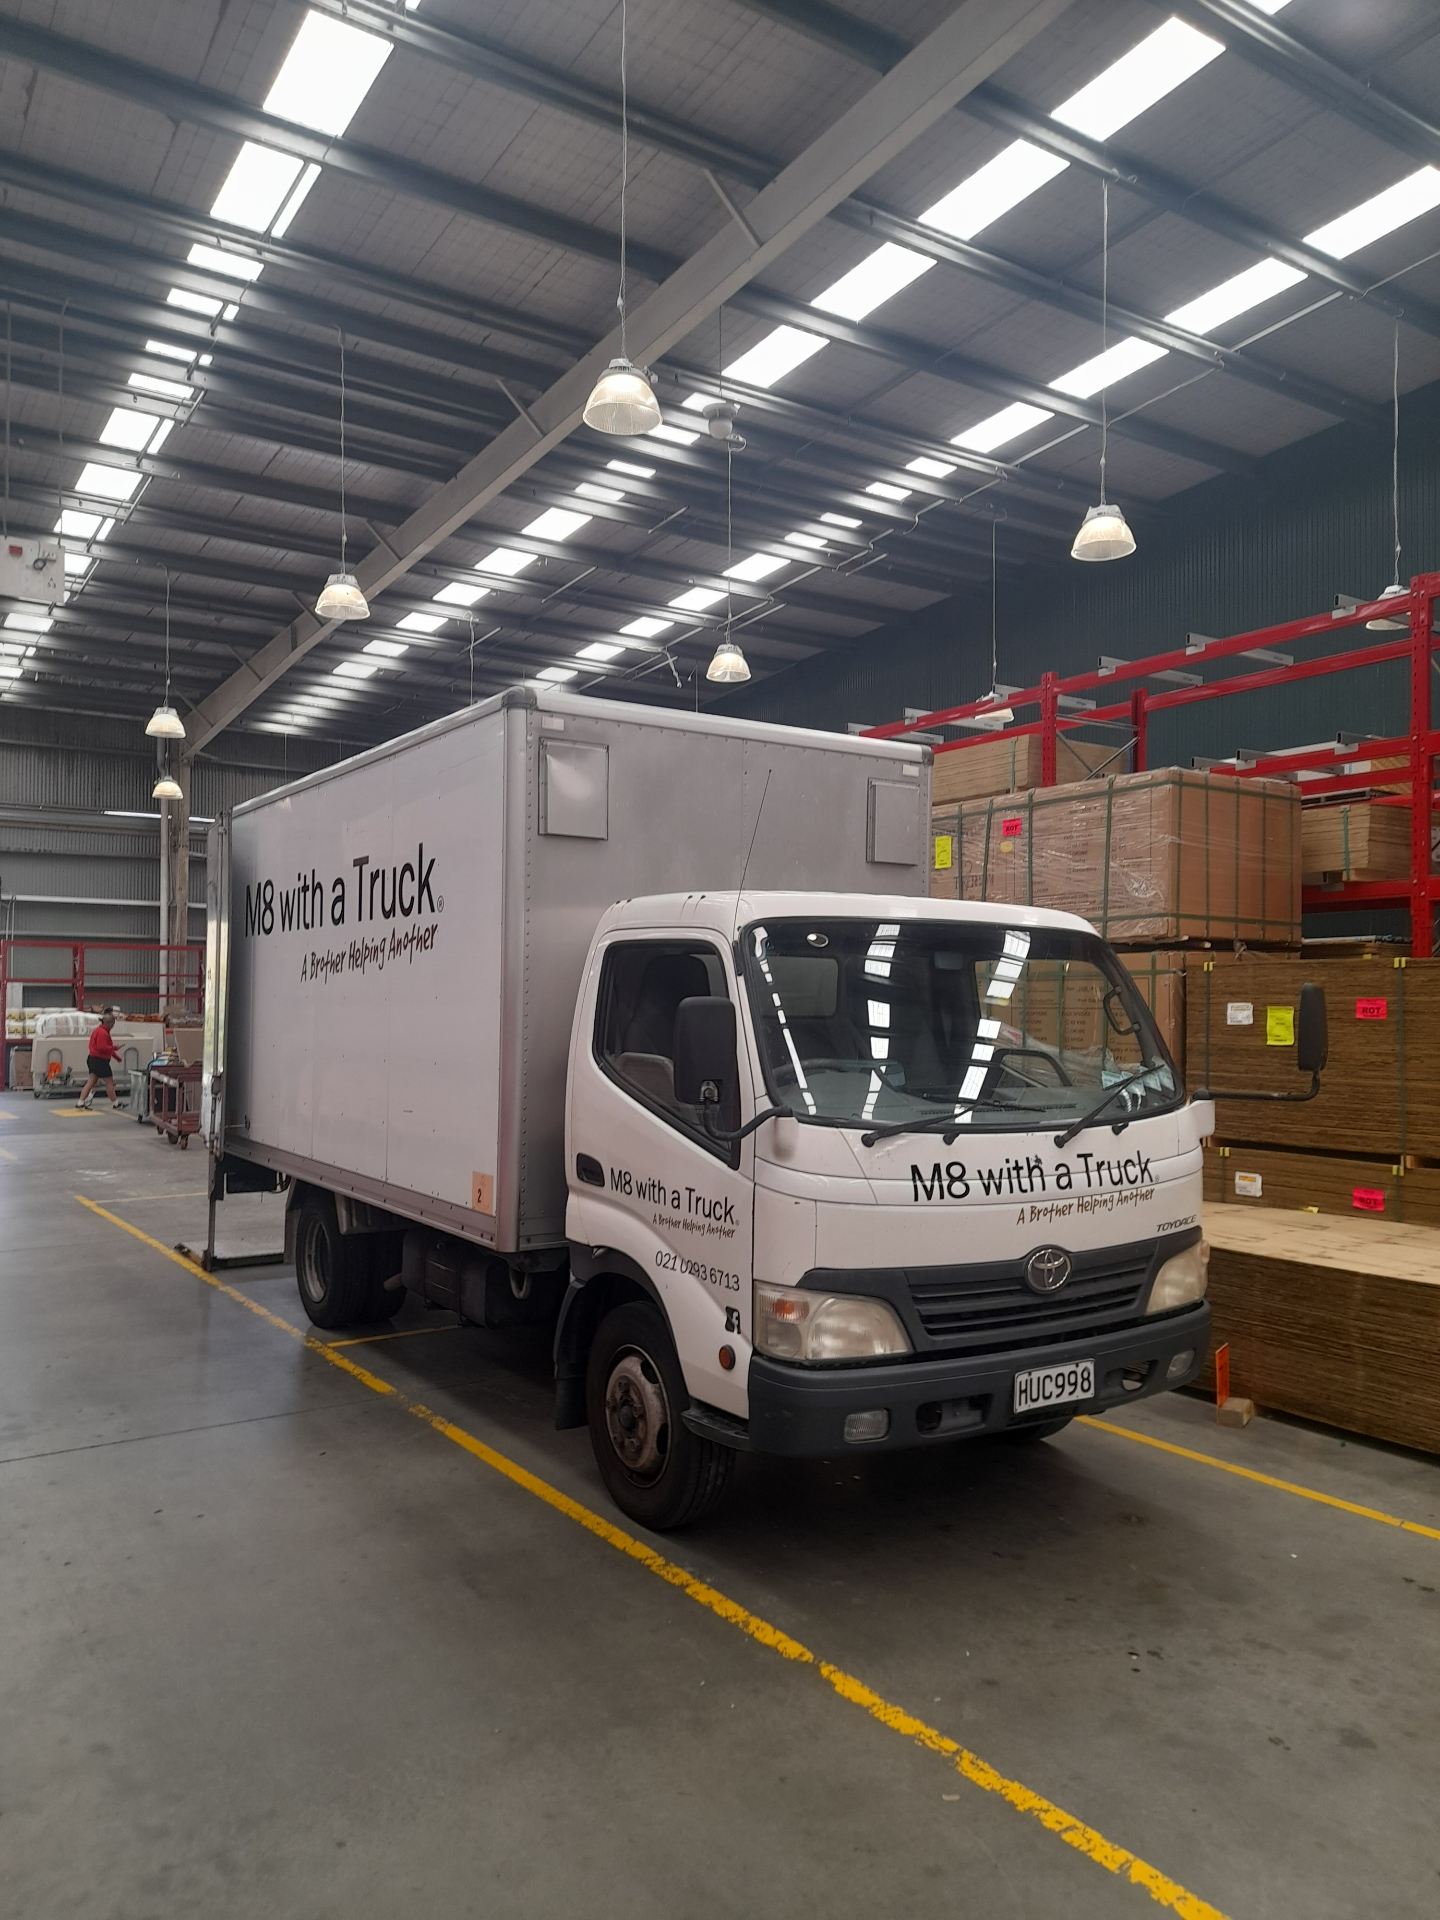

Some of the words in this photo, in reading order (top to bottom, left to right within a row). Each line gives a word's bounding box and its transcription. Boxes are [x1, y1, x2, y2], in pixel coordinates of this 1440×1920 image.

[245, 879, 274, 938] M8
[280, 868, 323, 932] with
[331, 877, 345, 926] a
[300, 953, 307, 983] A
[309, 949, 346, 985] Brother
[348, 937, 387, 975] Helping
[387, 923, 438, 965] Another
[477, 1188, 482, 1203] 2
[610, 1167, 632, 1196] M8
[636, 1178, 666, 1206] with
[671, 1189, 680, 1210] a
[910, 1161, 970, 1202] M8
[977, 1157, 1045, 1197] with
[1056, 1163, 1073, 1191] a
[652, 1213, 658, 1225] A
[658, 1213, 681, 1230] Brother
[682, 1218, 705, 1236] Helping
[706, 1221, 736, 1240] Another
[1016, 1208, 1025, 1226] A
[1029, 1200, 1074, 1224] Brother
[1077, 1194, 1114, 1215] Helping
[1116, 1188, 1155, 1209] Another
[655, 1250, 677, 1271] 021
[680, 1259, 708, 1281] 0293
[710, 1267, 740, 1291] 6713
[1018, 1366, 1092, 1407] HUC998
